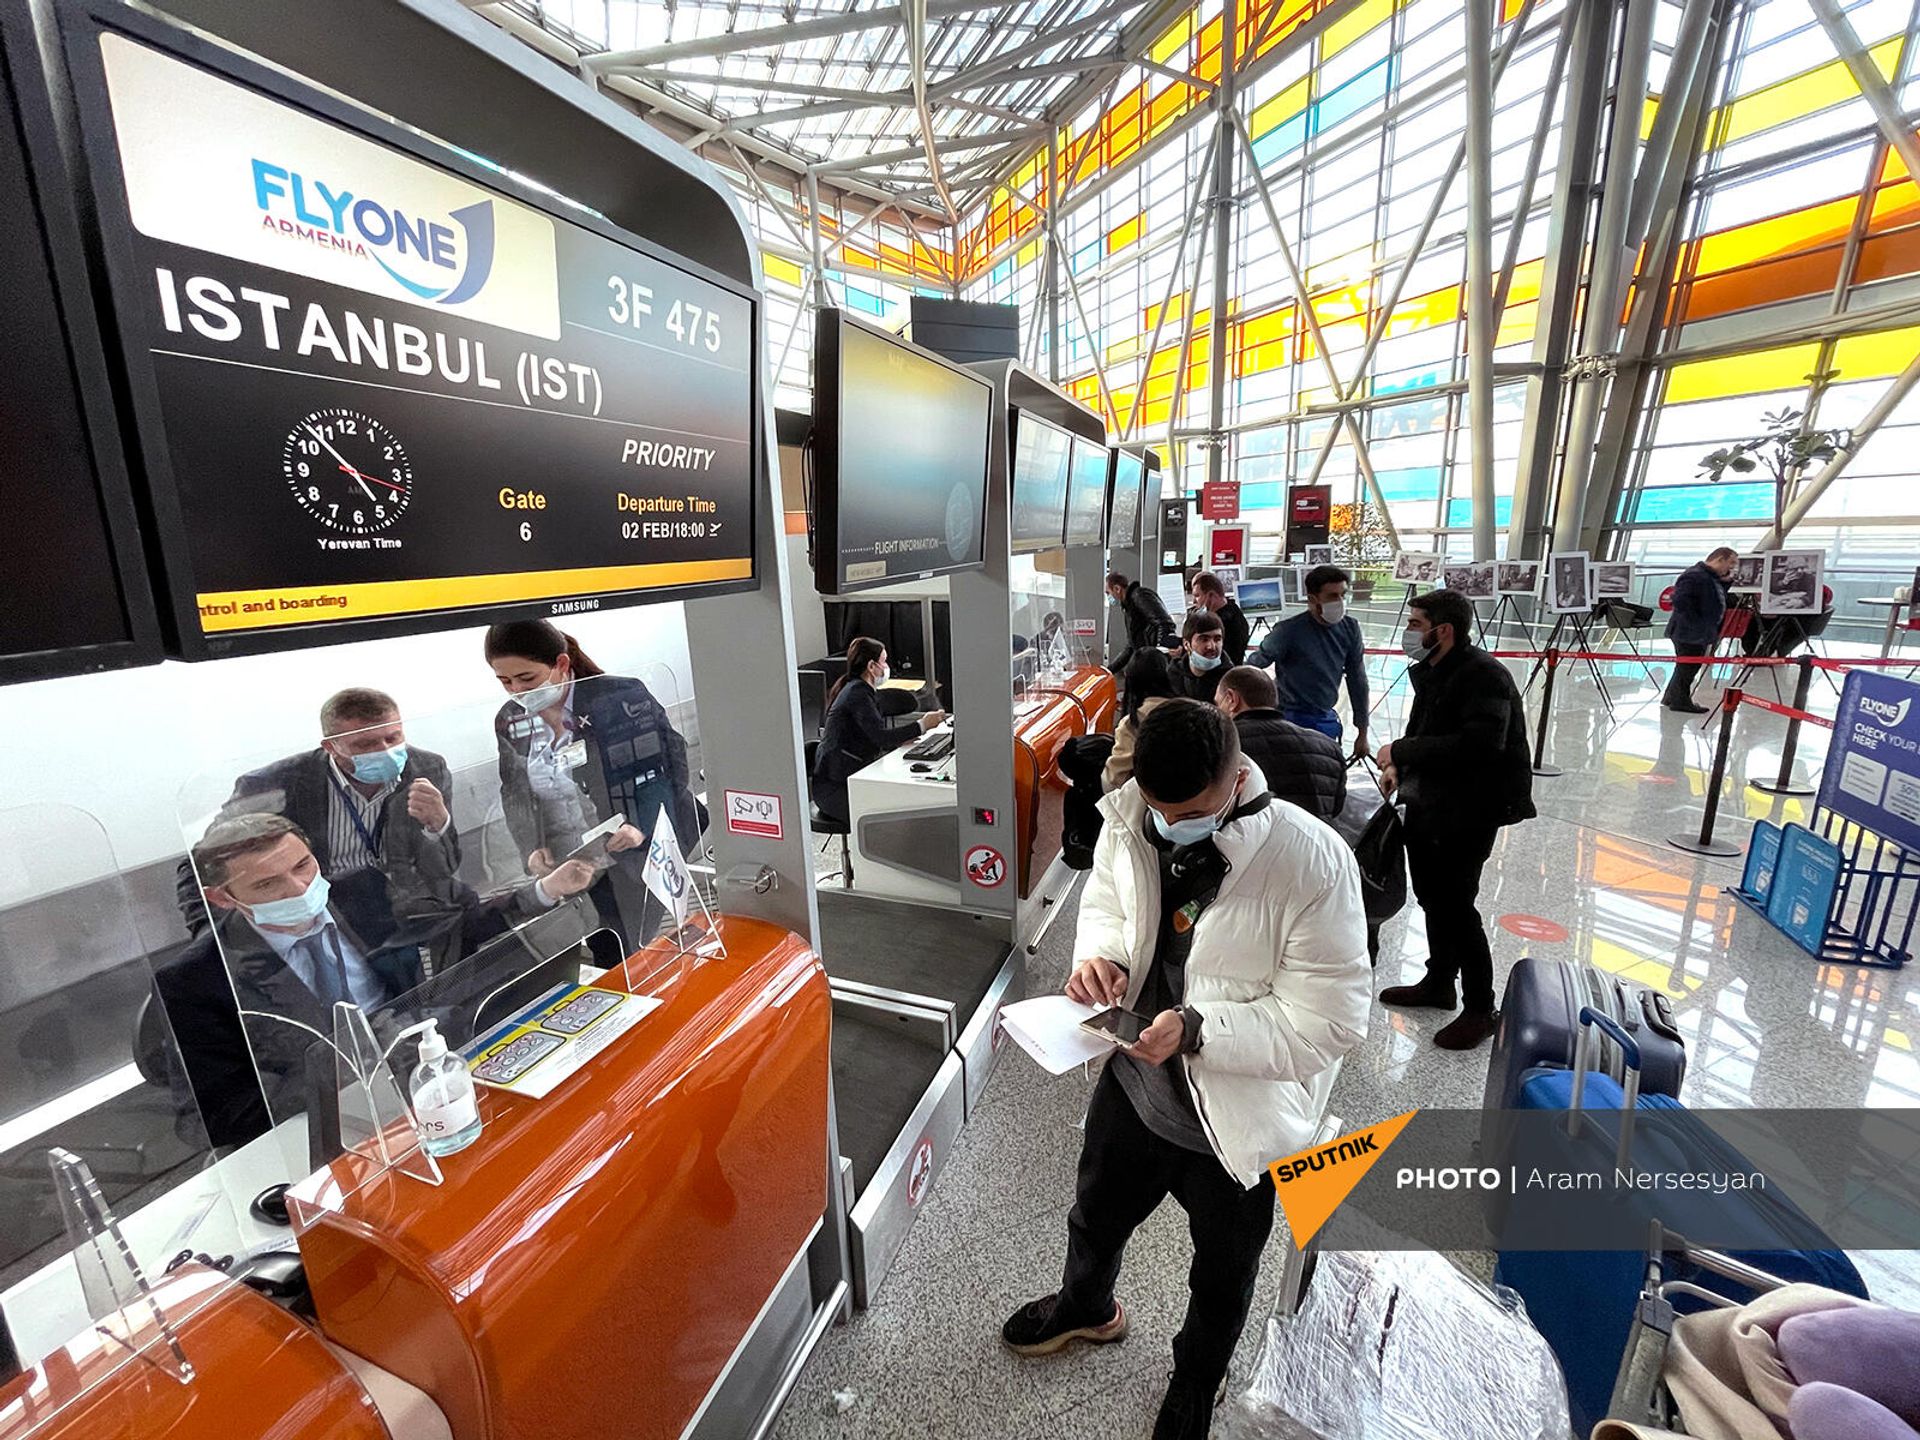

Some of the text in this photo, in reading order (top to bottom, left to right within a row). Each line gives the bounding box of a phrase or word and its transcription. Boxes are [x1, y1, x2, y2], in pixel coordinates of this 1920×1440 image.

[251, 157, 458, 271] FLYONE
[261, 214, 370, 260] ARMENIA
[607, 275, 721, 352] 3F 475
[154, 266, 604, 416] ISTANBUL (IST)
[315, 424, 334, 441] 11
[336, 419, 357, 435] 12
[366, 428, 375, 443] 1
[298, 439, 320, 456] 10
[383, 446, 394, 460] 2
[621, 438, 716, 472] PRIORITY
[297, 462, 310, 477] 9
[391, 468, 402, 482] 3
[308, 486, 320, 501] 8
[388, 489, 399, 503] 4
[499, 487, 547, 511] Gate
[328, 504, 339, 518] 7
[375, 505, 385, 519] 5
[617, 492, 716, 516] Departure Time
[353, 510, 364, 524] 6
[519, 522, 532, 542] 6
[621, 518, 706, 540] 02 FEB/18:00
[317, 537, 402, 551] Yerevan Time
[874, 537, 939, 555] FLIGHT INFORMATION
[243, 599, 275, 613] and
[280, 594, 348, 611] boarding
[551, 599, 600, 615] SAMSUNG
[1860, 697, 1899, 718] FLYONE
[1852, 733, 1878, 750] HERE
[1854, 722, 1888, 742] CHECK
[1888, 731, 1917, 752] YOUR
